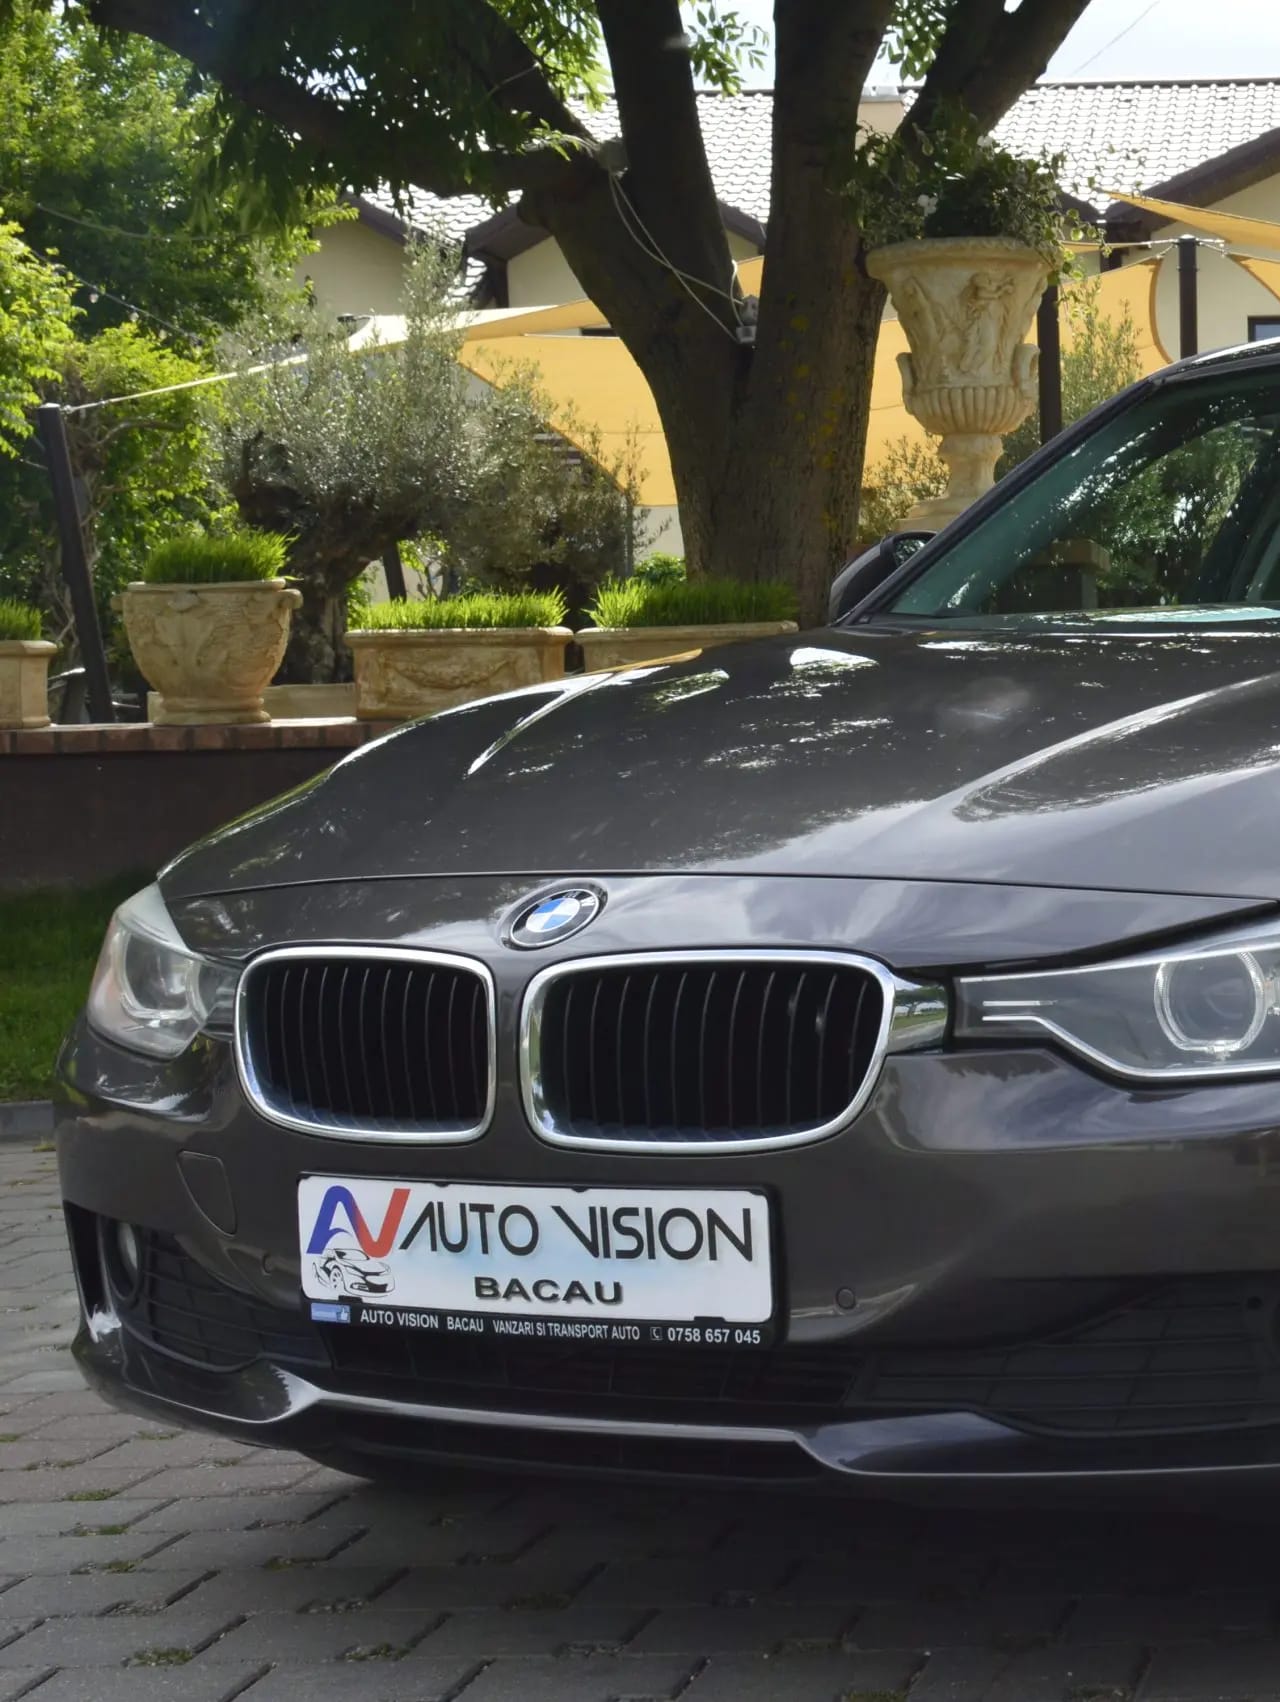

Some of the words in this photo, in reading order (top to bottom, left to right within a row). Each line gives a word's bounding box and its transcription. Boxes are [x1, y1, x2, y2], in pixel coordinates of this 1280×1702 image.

[398, 1201, 540, 1257] AUTO
[551, 1205, 753, 1262] VISION
[474, 1276, 623, 1305] BACAU
[360, 1308, 393, 1326] AUTO
[397, 1311, 439, 1329] VISION
[447, 1315, 484, 1333] BACAU
[493, 1319, 534, 1336] VANZARI
[536, 1322, 546, 1336] SI
[548, 1322, 608, 1339] TRANSPORT
[611, 1326, 640, 1341] AUTO
[667, 1327, 701, 1343] 0758
[705, 1328, 730, 1344] 657
[735, 1329, 761, 1345] 045
